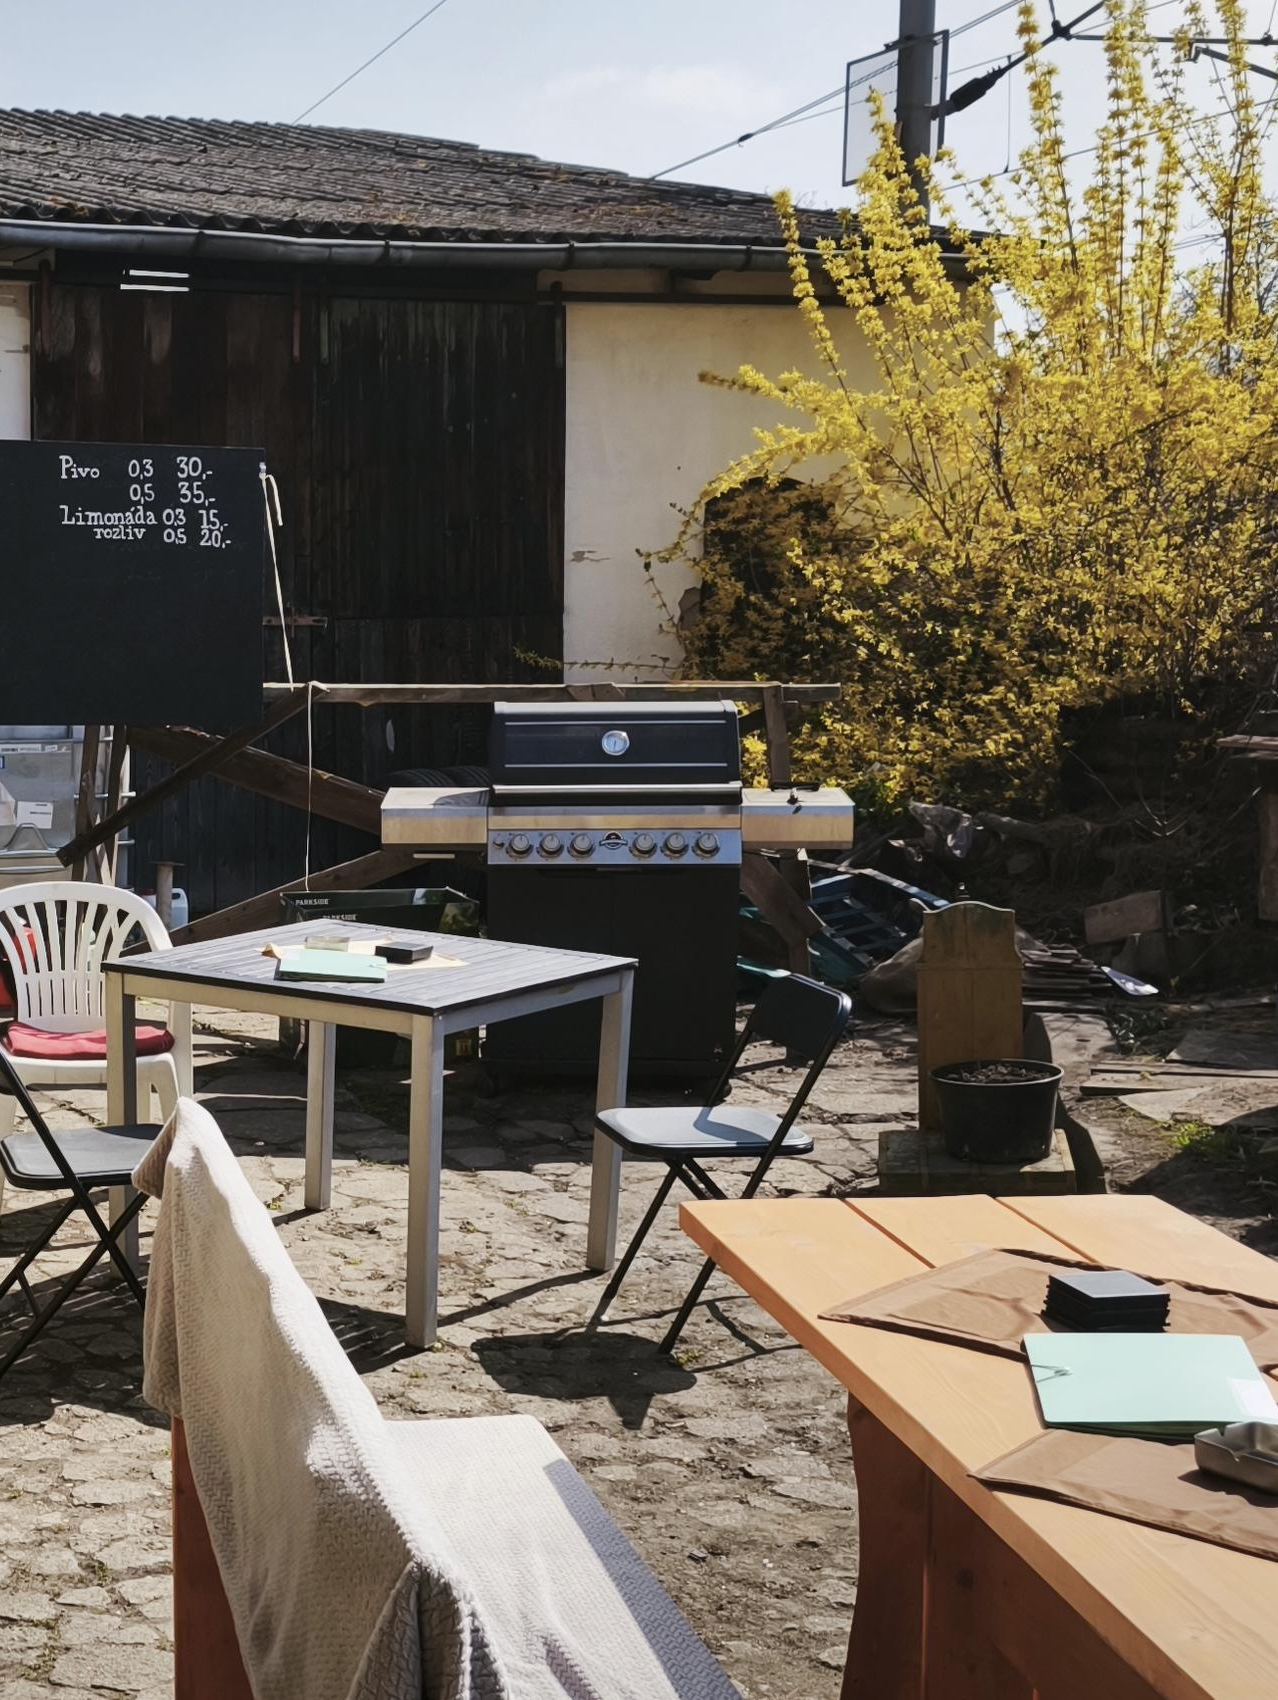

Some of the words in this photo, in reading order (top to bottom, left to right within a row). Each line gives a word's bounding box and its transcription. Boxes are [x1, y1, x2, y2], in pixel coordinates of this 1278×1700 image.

[58, 454, 101, 480] Pivo
[128, 458, 154, 480] 0,3
[176, 456, 214, 480] 30,-
[129, 483, 155, 505] 0,5
[178, 481, 216, 507] 35,-
[59, 504, 158, 526] Limonáda
[162, 508, 187, 527] 0,3
[198, 509, 229, 532] 15,-
[93, 525, 147, 540] rozliv
[163, 528, 187, 545] 0,5
[199, 529, 232, 549] 20,-
